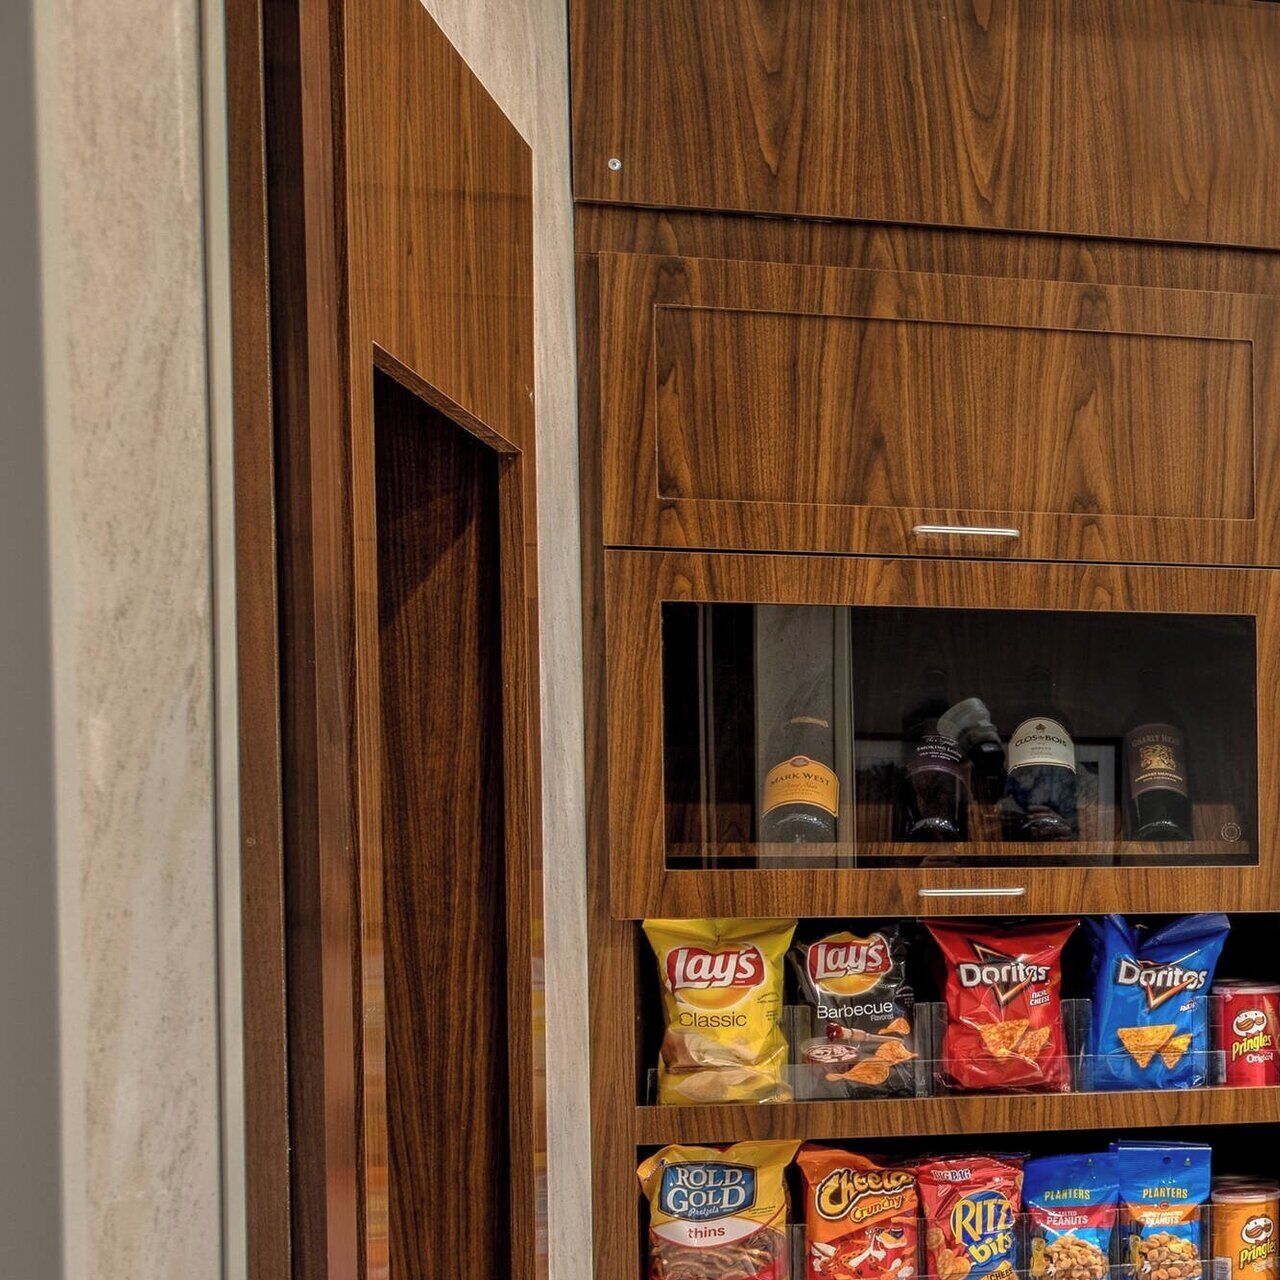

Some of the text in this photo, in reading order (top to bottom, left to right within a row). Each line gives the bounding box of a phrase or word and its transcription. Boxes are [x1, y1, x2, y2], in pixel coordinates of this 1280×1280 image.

[1015, 734, 1038, 747] CLOS
[1045, 735, 1068, 747] BOIS
[770, 773, 831, 786] MARK WEST
[674, 948, 758, 989] Lay's
[813, 937, 888, 979] Lay's
[959, 961, 1051, 988] Doritos
[1117, 959, 1208, 989] Doritos
[678, 1012, 747, 1028] Classic
[817, 1001, 893, 1020] Barbecue
[1231, 1032, 1273, 1060] Pringles
[677, 1166, 742, 1188] ROLD
[667, 1187, 746, 1213] GOLD
[1045, 1189, 1091, 1201] PLANTERS
[1143, 1188, 1188, 1199] PLANTERS
[850, 1195, 904, 1223] Crunchy
[955, 1198, 1014, 1244] RITZ
[1047, 1215, 1088, 1225] PEANUTS
[688, 1225, 725, 1239] thins
[968, 1233, 1013, 1264] bits
